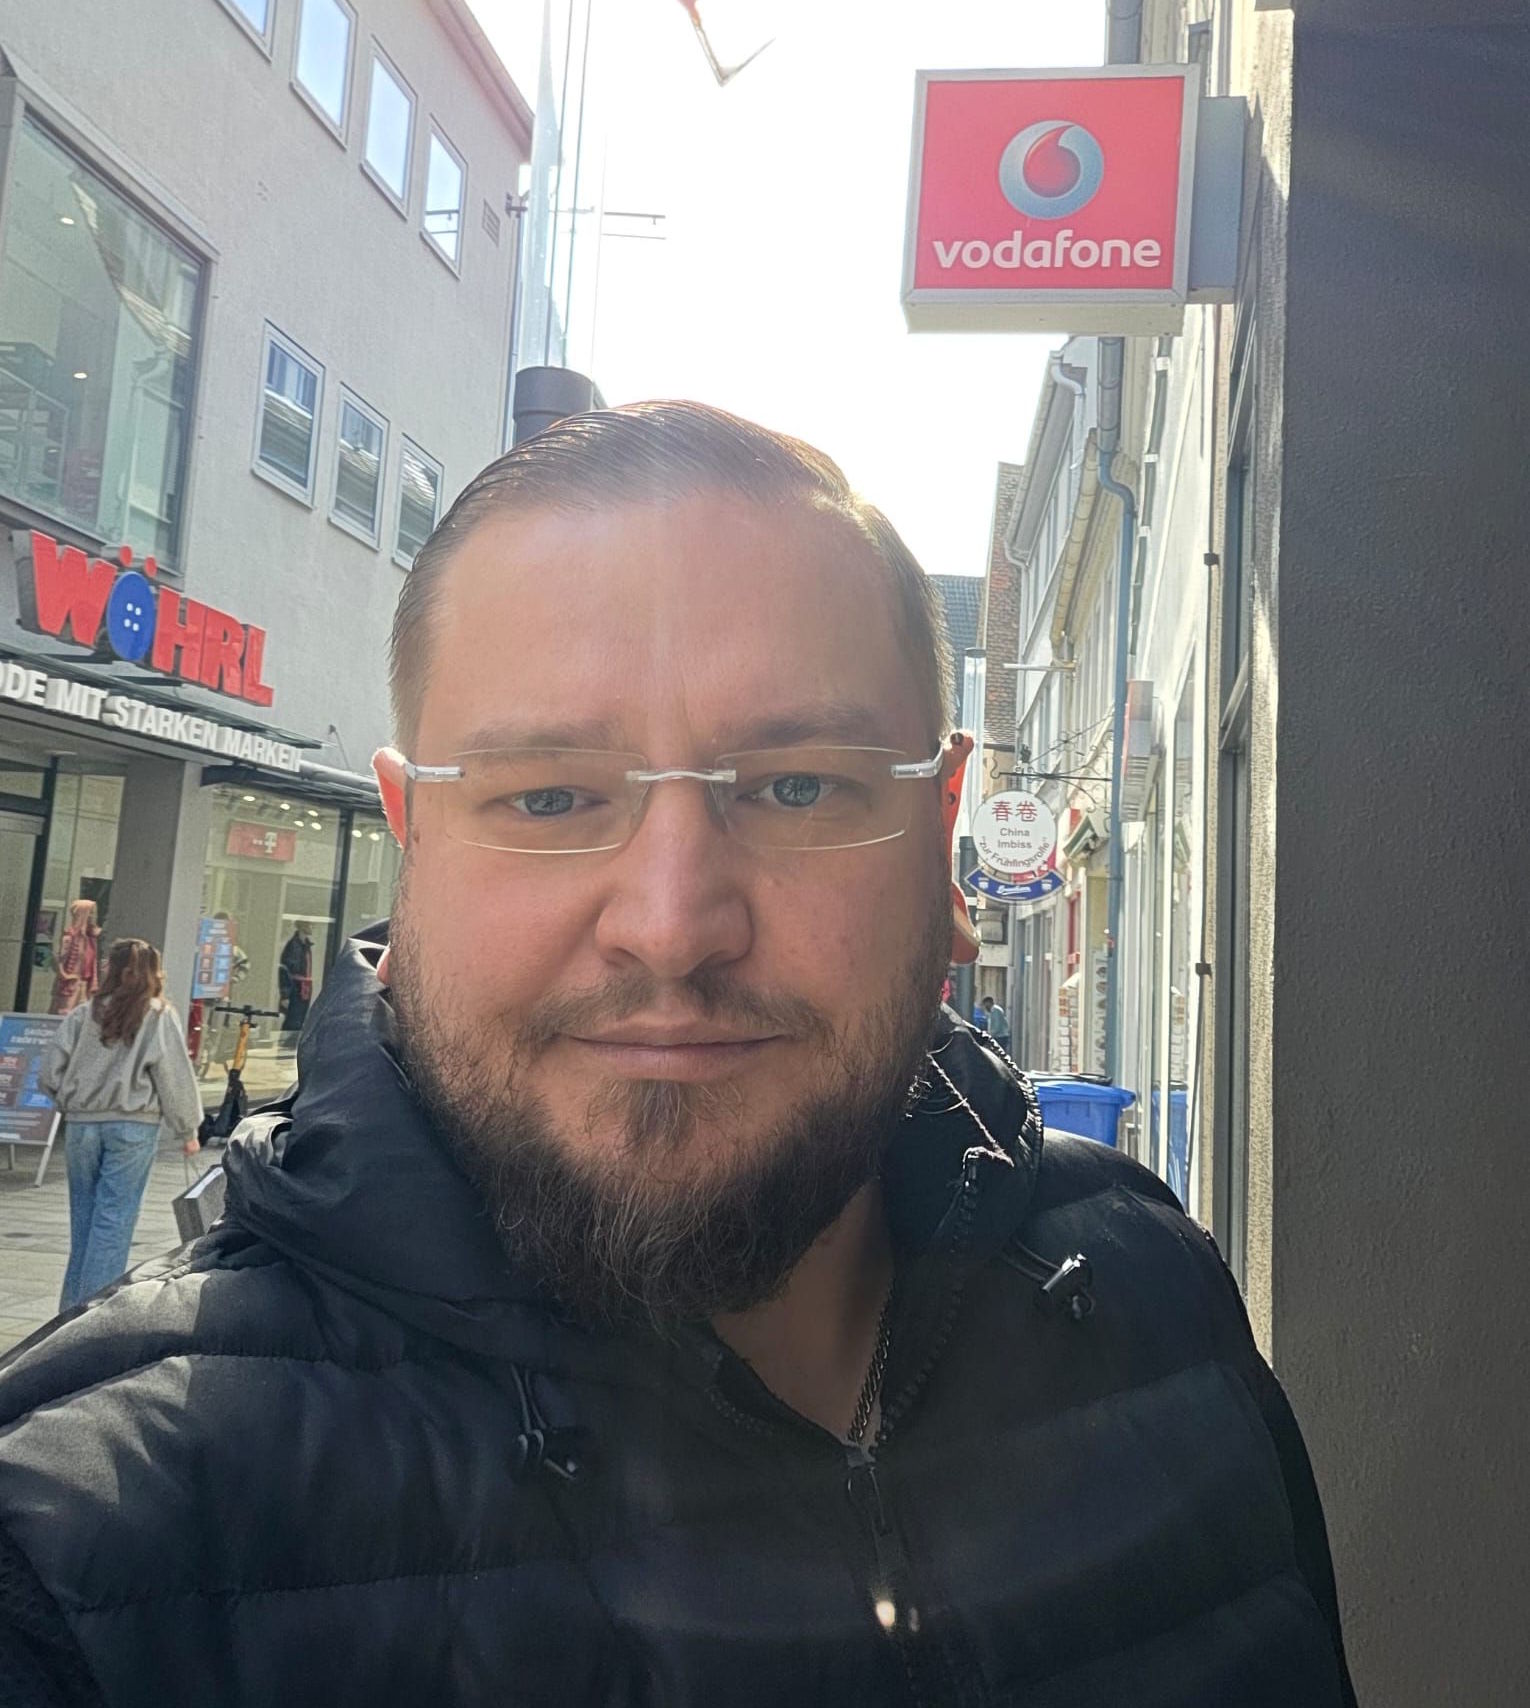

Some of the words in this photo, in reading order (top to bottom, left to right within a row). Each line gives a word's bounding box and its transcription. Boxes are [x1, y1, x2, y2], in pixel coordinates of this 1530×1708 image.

[933, 229, 1161, 269] vodafone
[0, 661, 48, 706] DE
[50, 678, 109, 720] MIT
[106, 695, 218, 753] STARKEN
[222, 726, 301, 773] MARKEN
[998, 840, 1032, 849] Imbiss
[999, 827, 1030, 837] China
